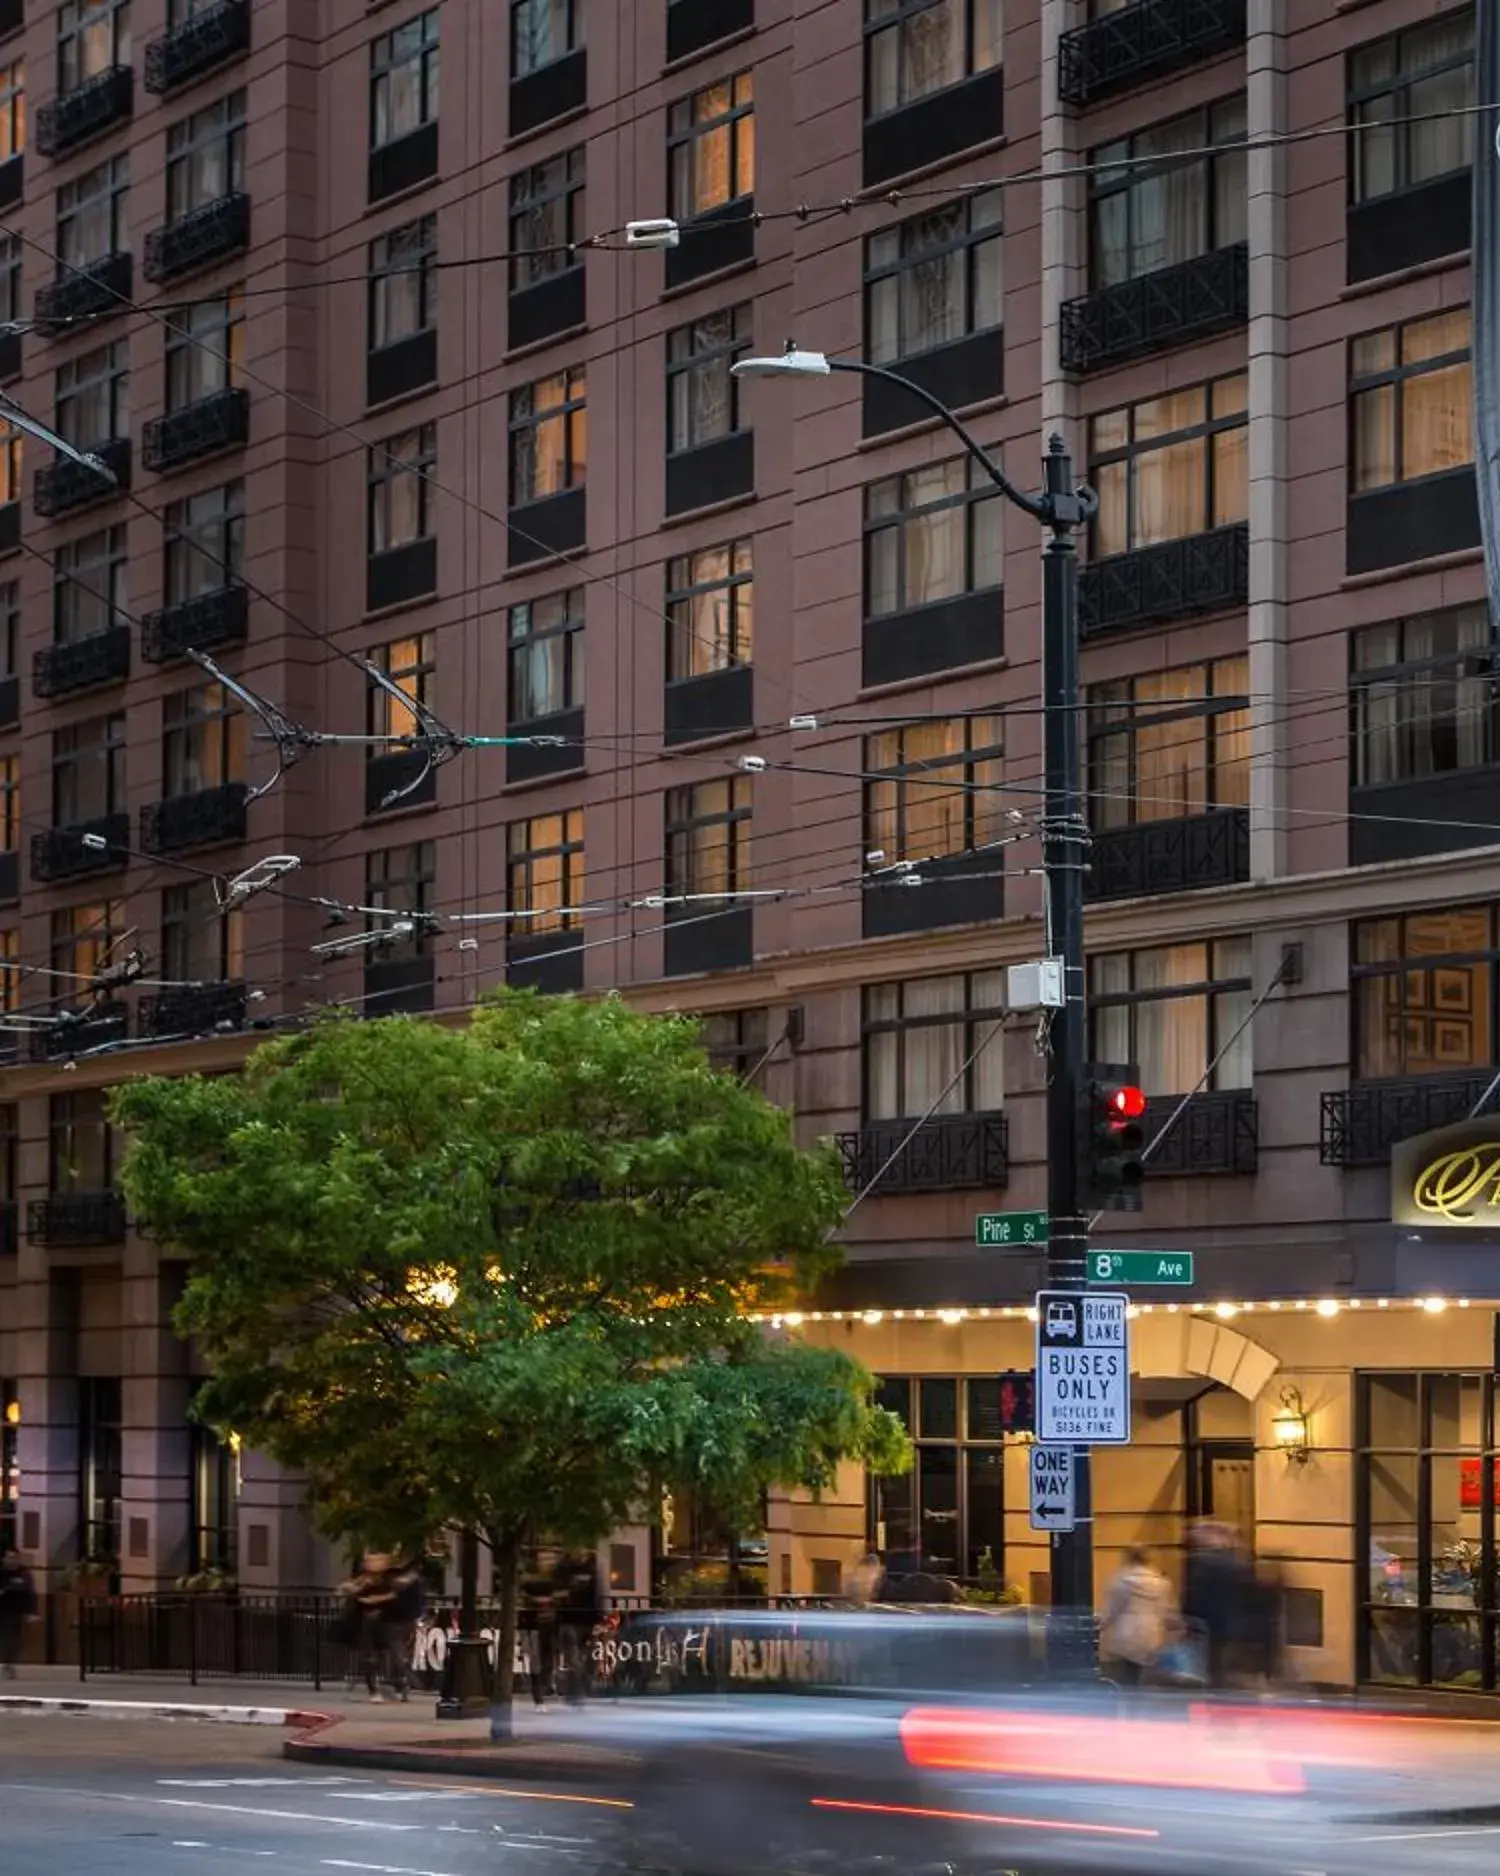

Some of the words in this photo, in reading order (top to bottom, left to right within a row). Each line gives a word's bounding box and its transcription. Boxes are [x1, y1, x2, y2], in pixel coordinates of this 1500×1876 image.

[982, 1218, 1011, 1241] Pine
[1023, 1223, 1035, 1239] St
[1157, 1260, 1184, 1277] Ave
[1085, 1303, 1122, 1321] RIGHT
[1087, 1323, 1121, 1340] LANE
[1049, 1355, 1118, 1376] BUSES
[1057, 1379, 1110, 1400] ONLY
[1051, 1406, 1098, 1418] BICYCLES
[1087, 1421, 1113, 1433] FINE
[1034, 1451, 1068, 1471] ONE
[1034, 1474, 1069, 1495] WAY
